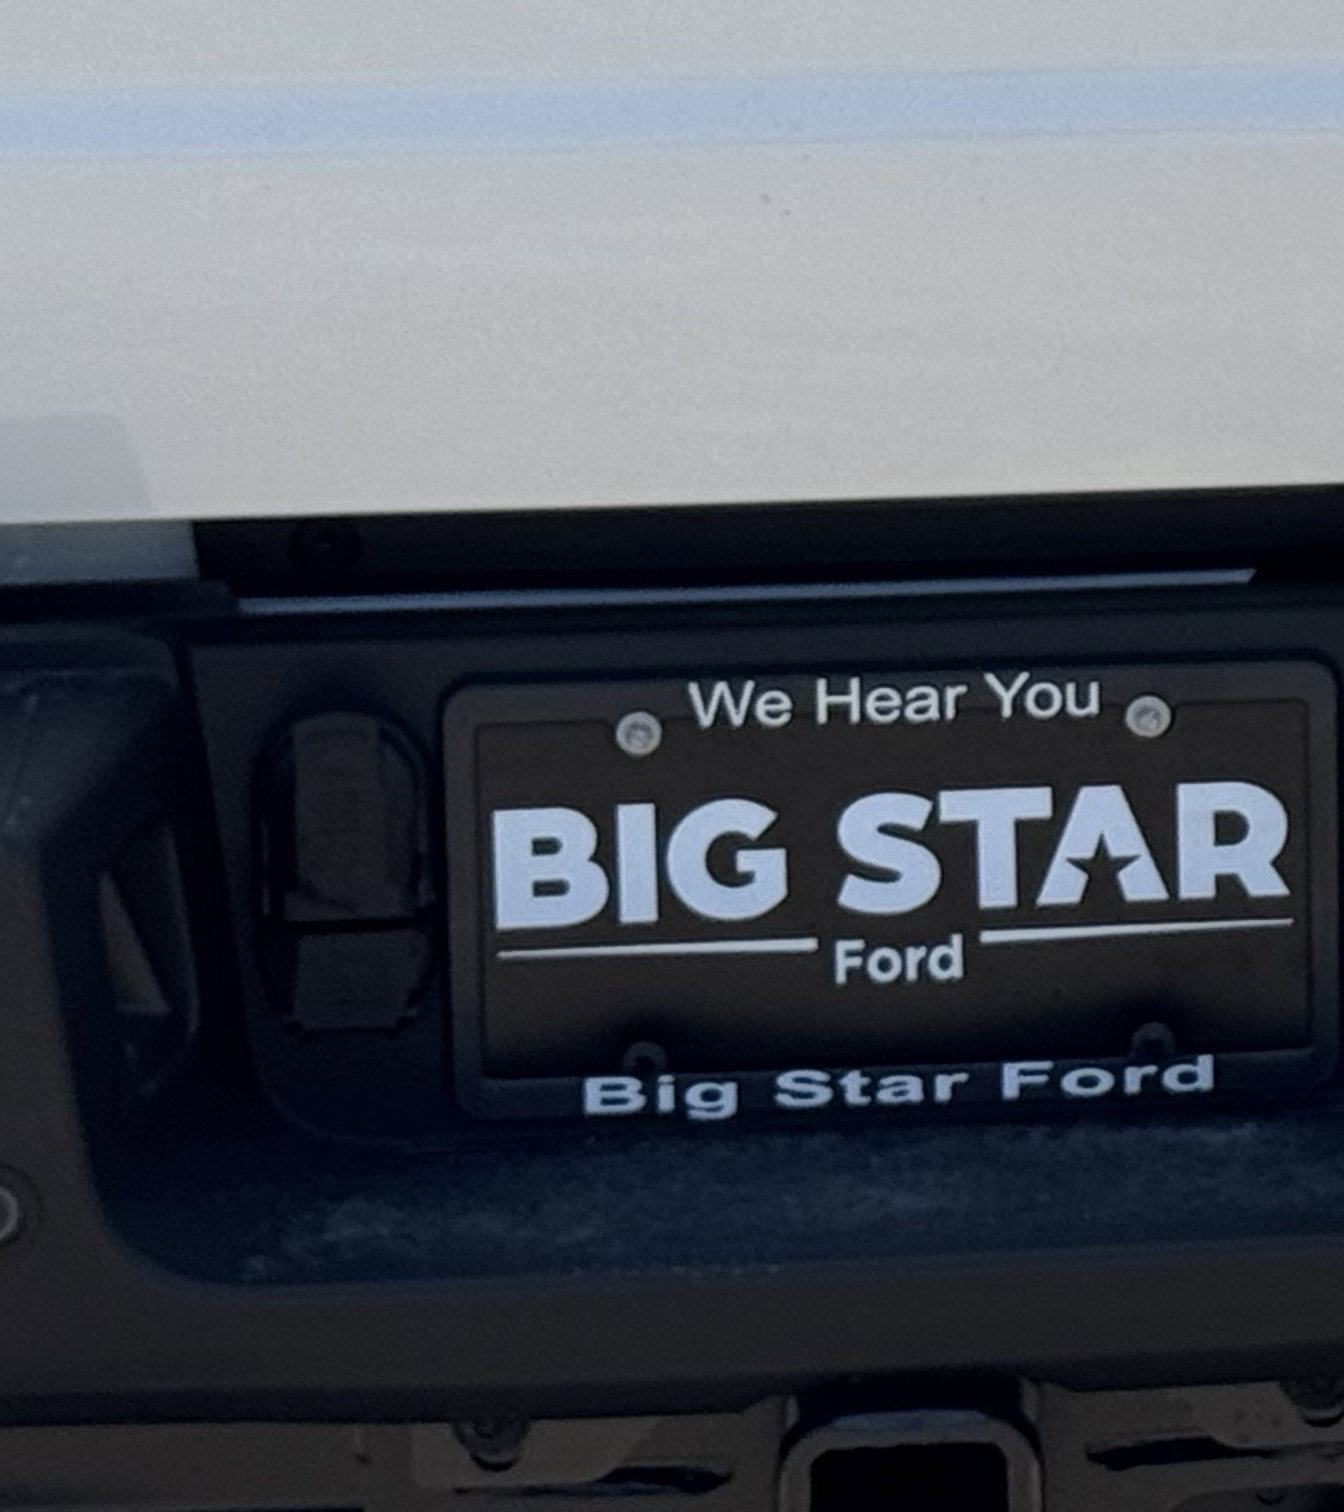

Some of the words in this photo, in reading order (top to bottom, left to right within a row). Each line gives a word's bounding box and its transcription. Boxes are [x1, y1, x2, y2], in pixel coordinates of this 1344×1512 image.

[687, 678, 794, 729] We
[814, 675, 968, 725] Hear
[982, 670, 1101, 720] You
[491, 797, 789, 931] BIG
[836, 780, 1292, 916] STAR
[833, 932, 965, 985] Ford
[582, 1074, 739, 1121] Big
[773, 1067, 969, 1109] Star
[1001, 1053, 1215, 1100] Ford
